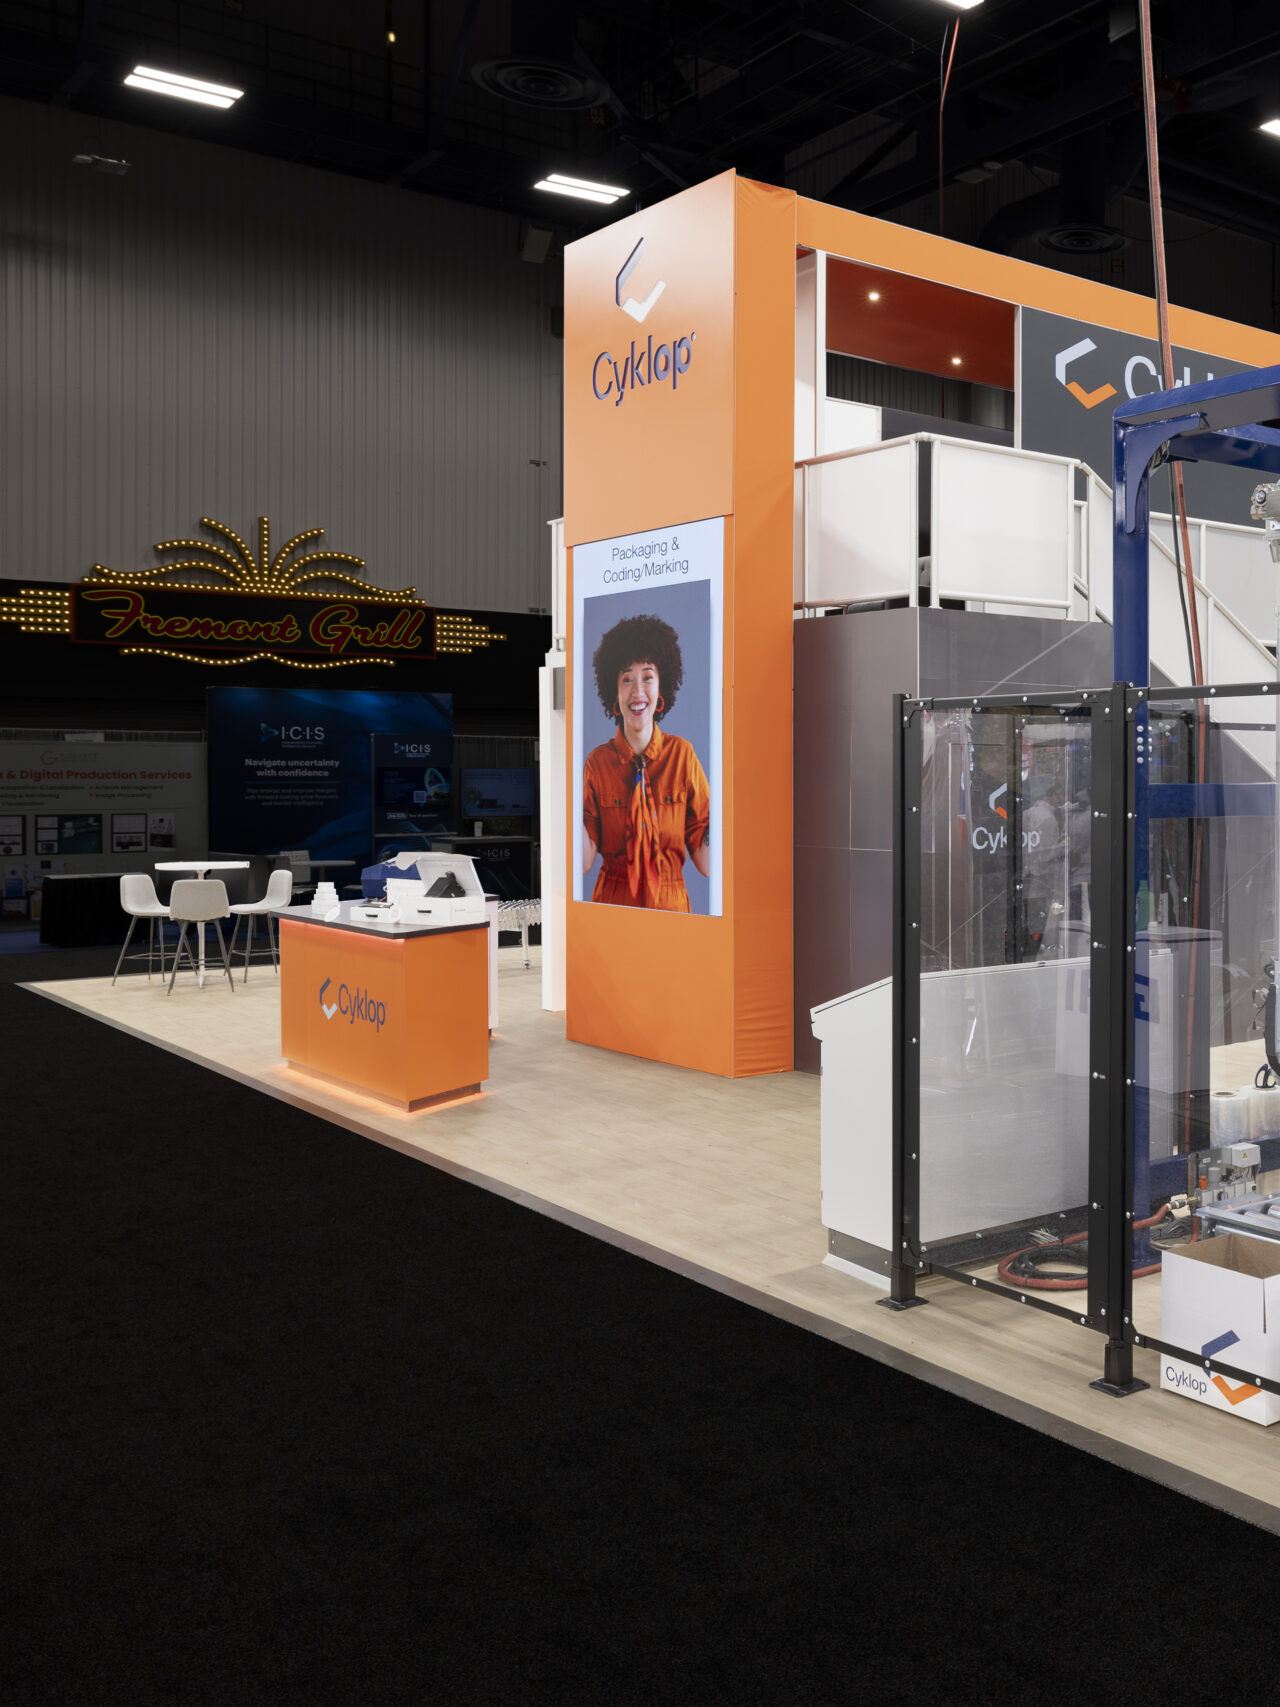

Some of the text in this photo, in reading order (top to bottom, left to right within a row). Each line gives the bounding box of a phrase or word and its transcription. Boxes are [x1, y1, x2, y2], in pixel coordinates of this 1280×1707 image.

[592, 333, 692, 407] Cyklop
[612, 536, 680, 561] Packaging &
[603, 558, 690, 584] Coding/Marking
[81, 589, 426, 654] Fremont Grill
[6, 769, 192, 782] & Digital Production Services
[244, 758, 340, 769] Navigate uncertainty
[256, 768, 329, 777] with confidence
[338, 983, 386, 1033] Cyklop
[1165, 1366, 1208, 1396] Cyklop
